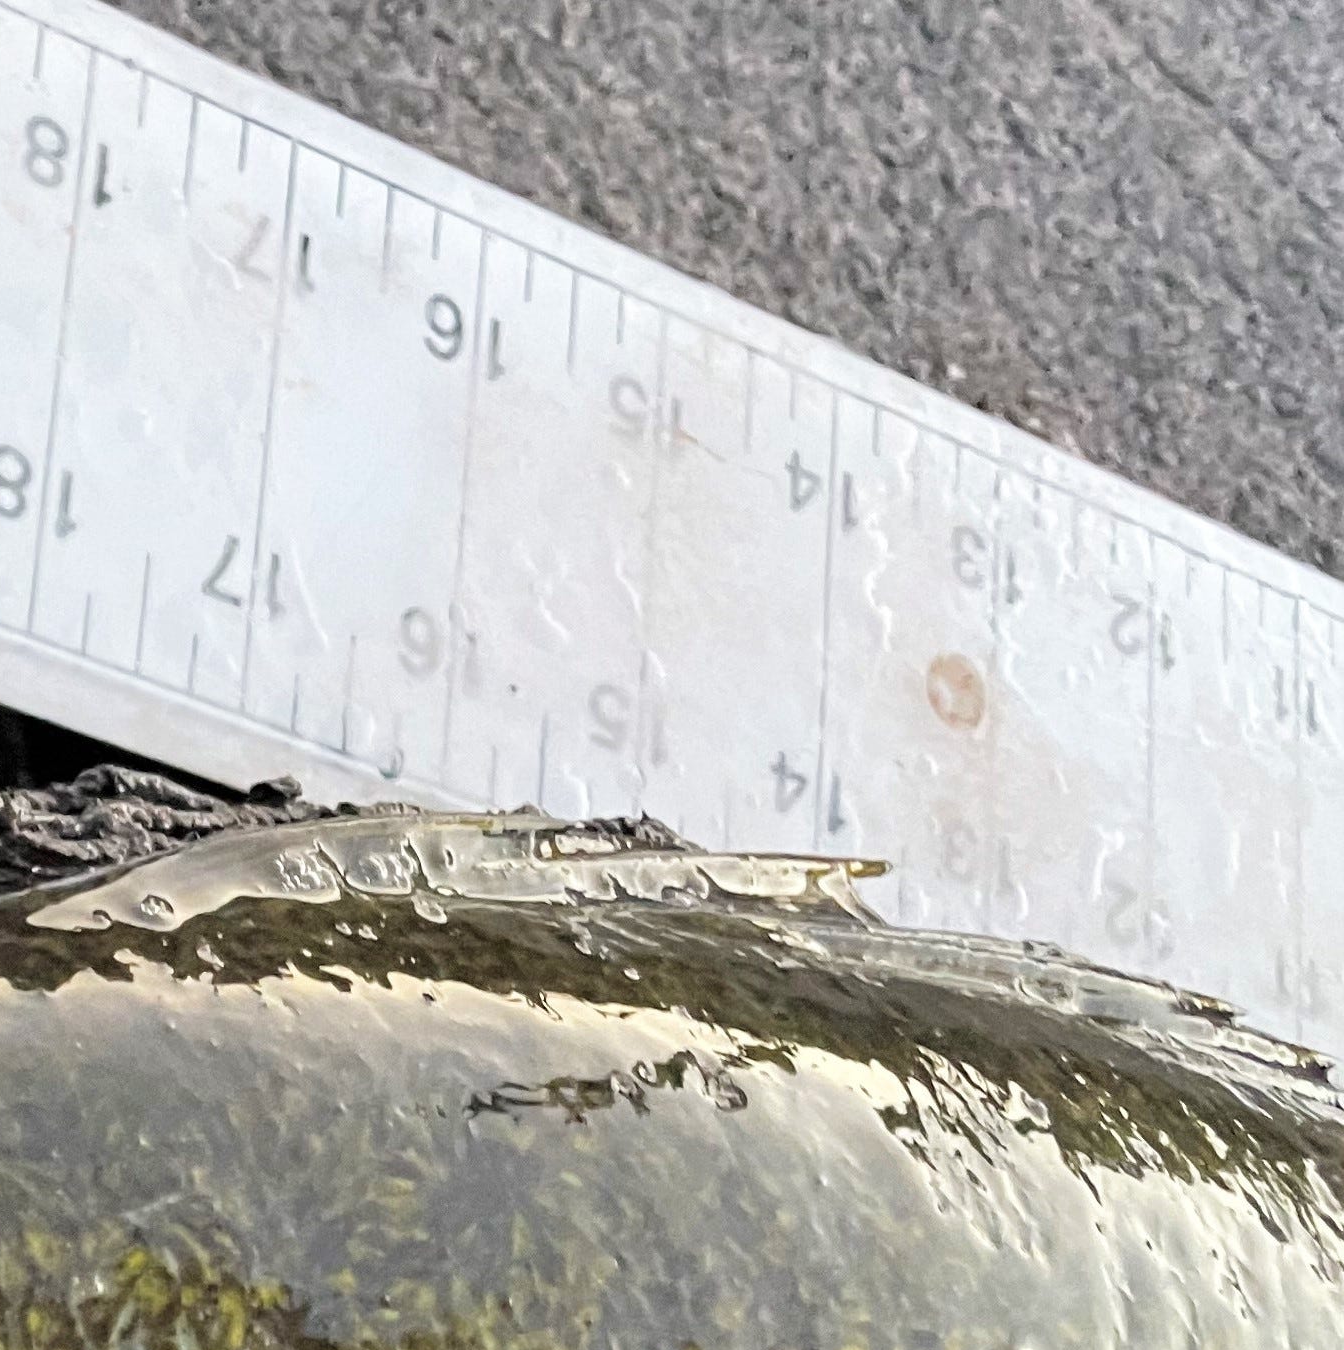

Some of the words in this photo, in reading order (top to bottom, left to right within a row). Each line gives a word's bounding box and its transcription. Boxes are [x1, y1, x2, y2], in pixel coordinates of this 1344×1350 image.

[24, 115, 112, 208] 18
[232, 215, 315, 293] 17
[423, 293, 506, 381] 16
[608, 373, 685, 447] 15
[785, 451, 856, 529] 14
[201, 535, 287, 619] 17
[953, 525, 1022, 605] 13
[398, 605, 483, 695] 16
[1111, 593, 1175, 671] 12
[588, 684, 668, 765] 15
[1273, 664, 1319, 734] 11
[771, 751, 844, 834] 14
